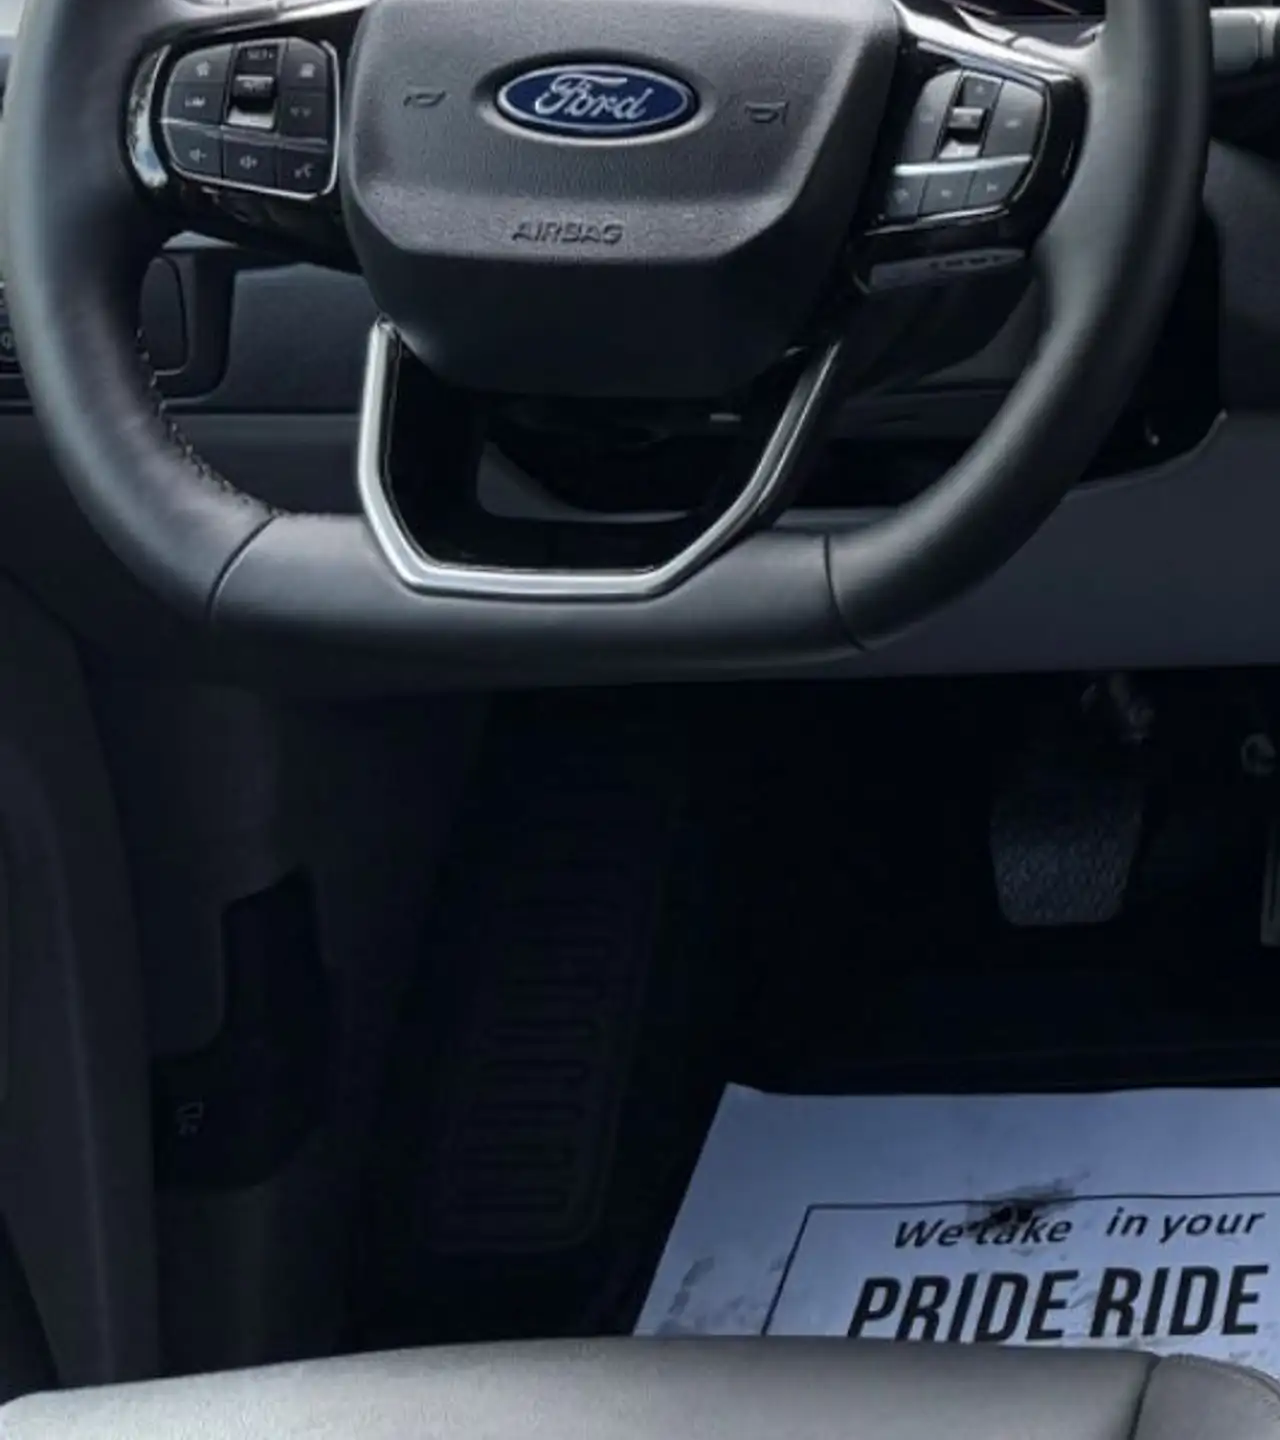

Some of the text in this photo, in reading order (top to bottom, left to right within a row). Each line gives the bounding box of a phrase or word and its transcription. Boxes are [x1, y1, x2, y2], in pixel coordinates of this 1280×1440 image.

[534, 71, 655, 120] Ford
[511, 220, 625, 245] AIRBAG
[894, 1205, 1265, 1249] We take in your
[847, 1264, 1269, 1343] PRIDE RIDE
